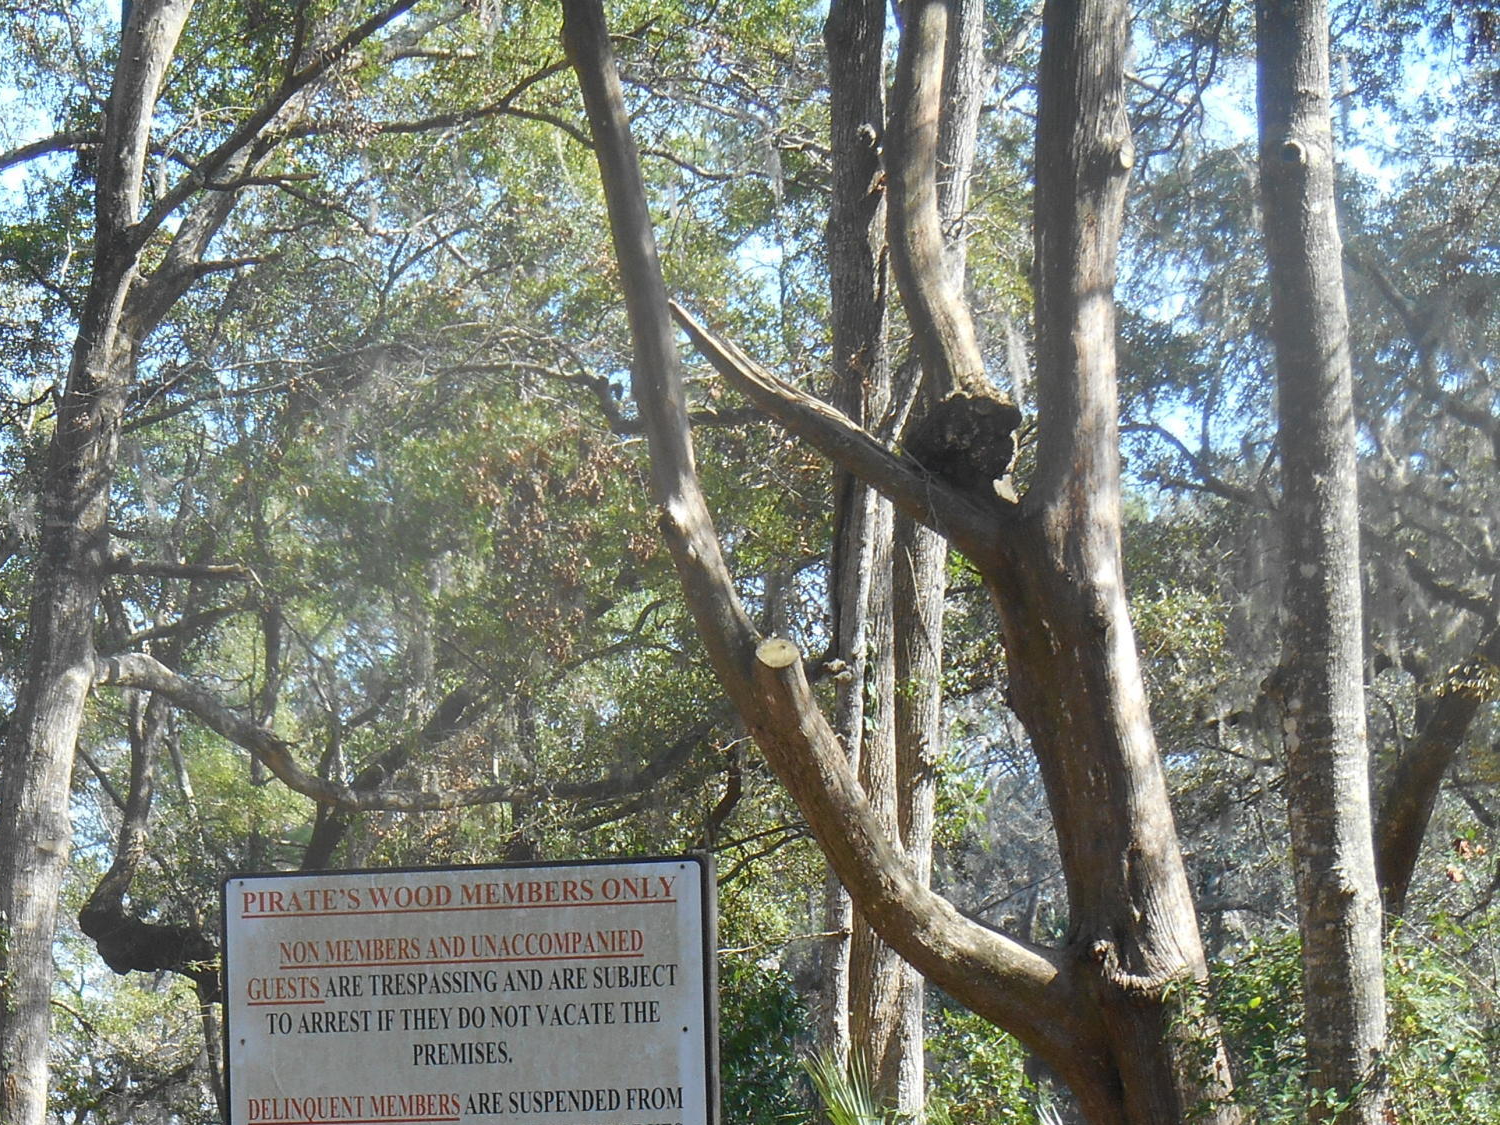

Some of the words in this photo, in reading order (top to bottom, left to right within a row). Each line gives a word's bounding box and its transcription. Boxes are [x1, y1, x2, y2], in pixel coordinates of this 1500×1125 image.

[242, 887, 361, 913] PIRATE'S
[368, 884, 452, 909] WOOD
[460, 879, 594, 905] MEMBERS
[601, 876, 676, 900] ONLY
[279, 940, 320, 963] NON
[325, 937, 421, 962] MEMBERS
[426, 935, 466, 959] AND
[472, 929, 644, 957] UNACCOMPANIED
[247, 976, 320, 1000] GUESTS
[325, 974, 363, 997] ARE
[368, 970, 497, 996] TRESPASSING
[503, 968, 543, 992] AND
[548, 967, 588, 991] ARE
[593, 963, 678, 989] SUBJECT
[266, 1012, 292, 1035] TO
[297, 1010, 372, 1034] ARREST
[377, 1008, 396, 1031] IF
[401, 1007, 453, 1030] THEY
[458, 1006, 485, 1029] DO
[491, 1004, 530, 1028] NOT
[536, 1002, 615, 1026] VACATE
[621, 1000, 661, 1024] THE
[412, 1041, 513, 1066] PREMISES.
[248, 1095, 364, 1122] DELINQUENT
[370, 1093, 461, 1118] MEMBERS
[464, 1091, 503, 1115] ARE
[508, 1088, 621, 1114] SUSPENDED
[626, 1086, 684, 1110] FROM
